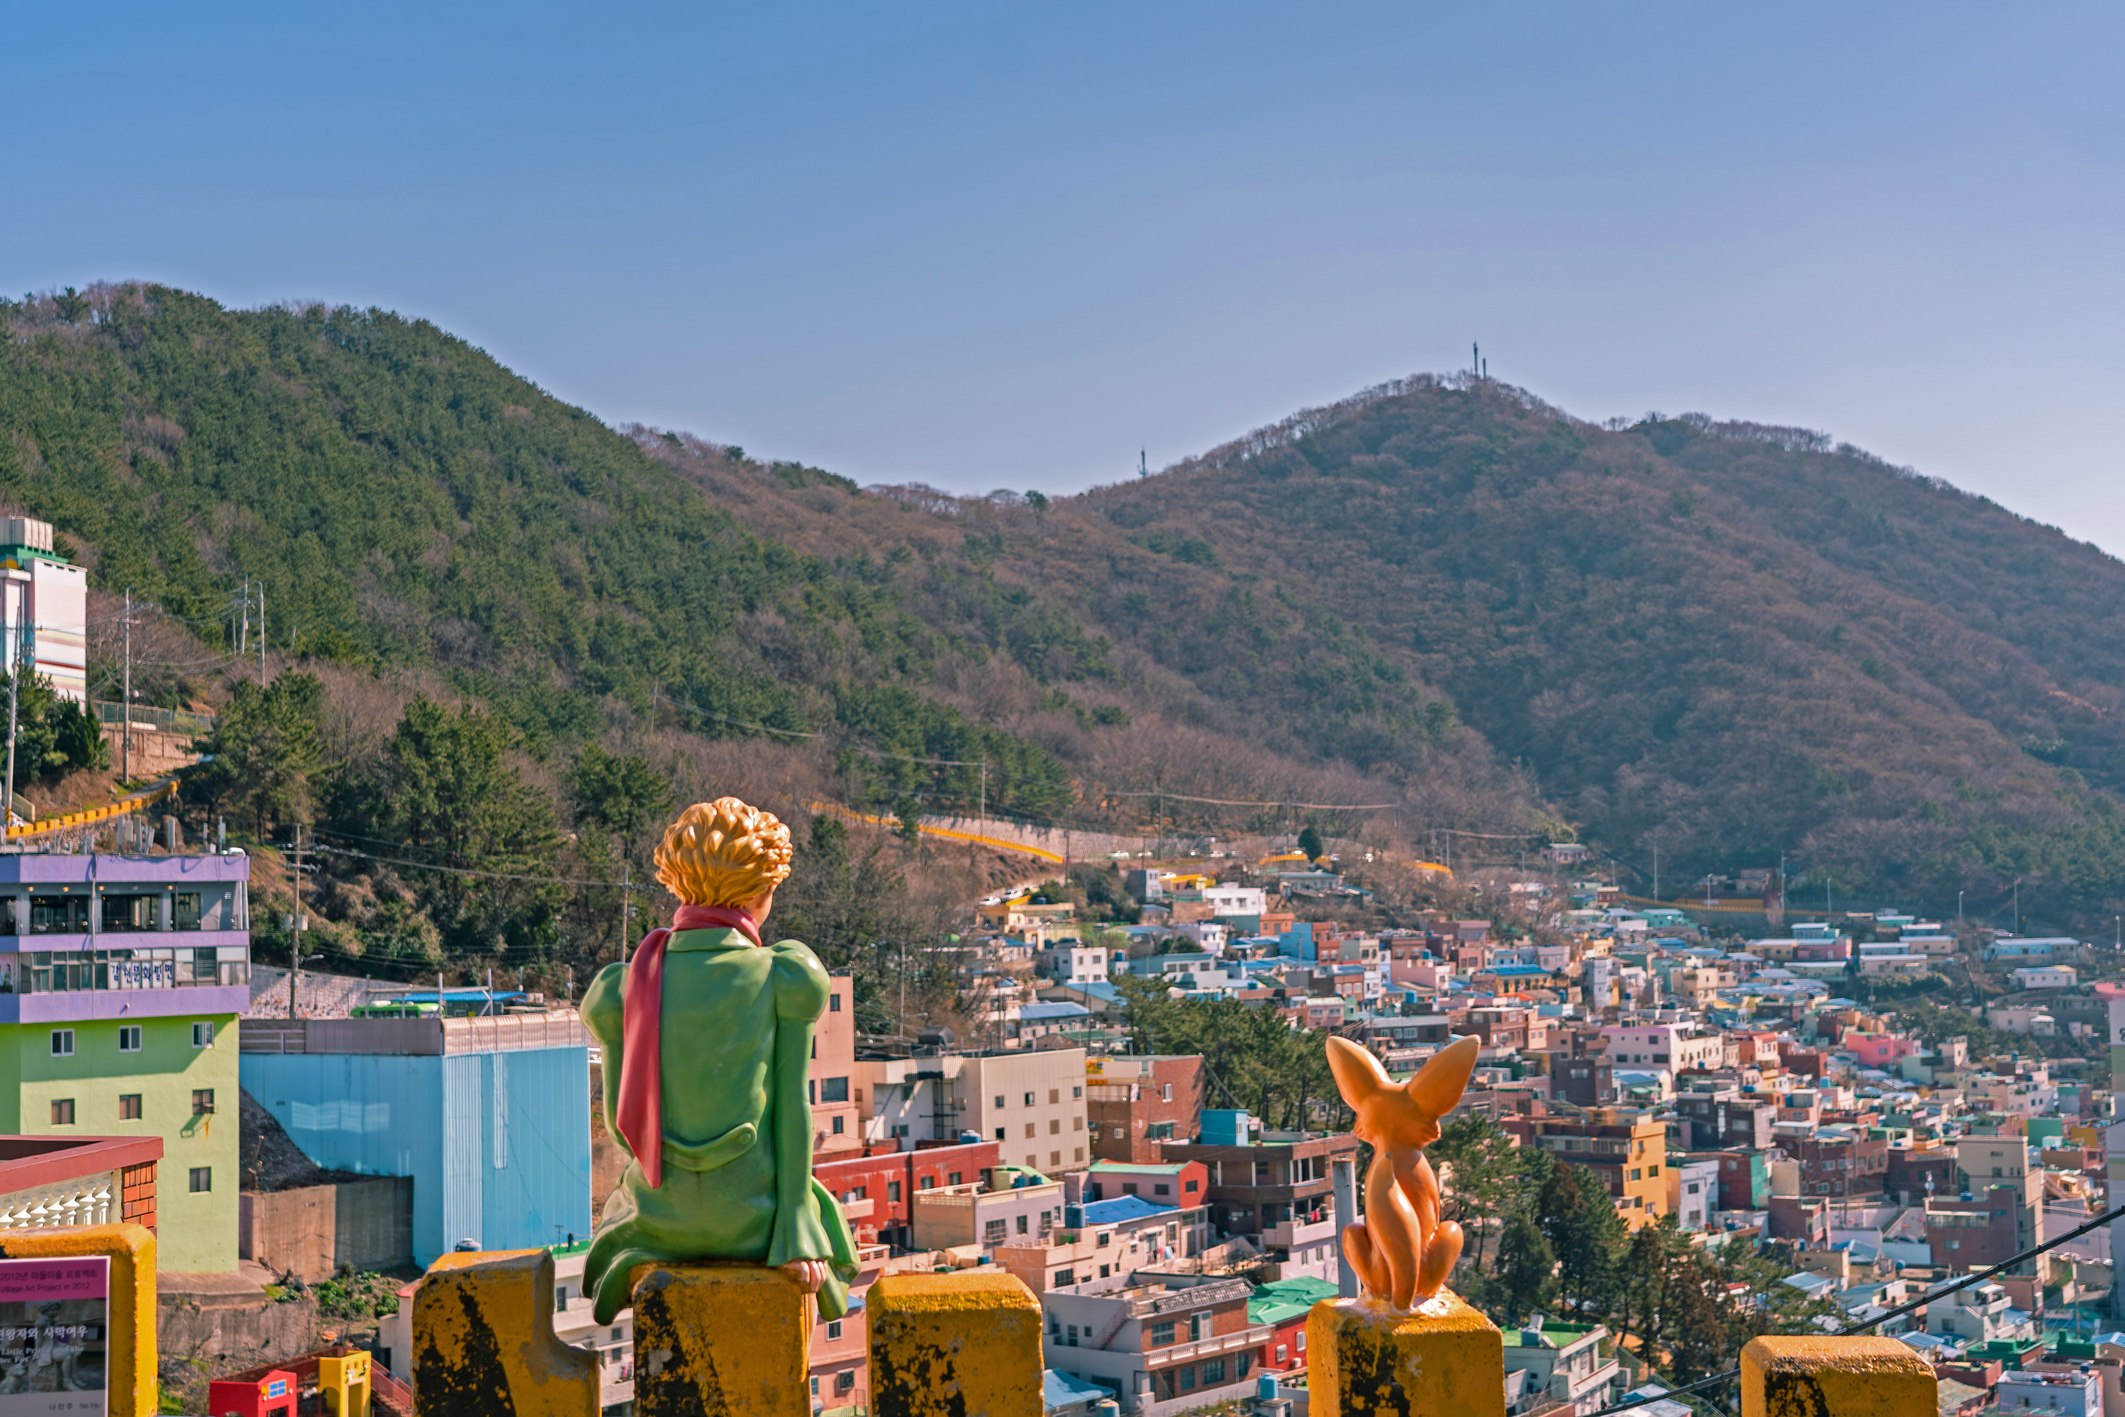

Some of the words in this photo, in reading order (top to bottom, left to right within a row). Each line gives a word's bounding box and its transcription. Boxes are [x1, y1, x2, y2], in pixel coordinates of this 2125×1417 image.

[66, 1269, 98, 1278] 프로젝트
[1, 1286, 23, 1294] Village
[25, 1284, 35, 1292] Art
[37, 1283, 62, 1292] Project
[72, 1282, 92, 1290] 2012
[43, 1325, 88, 1339] 사막여우
[1, 1347, 24, 1356] Little
